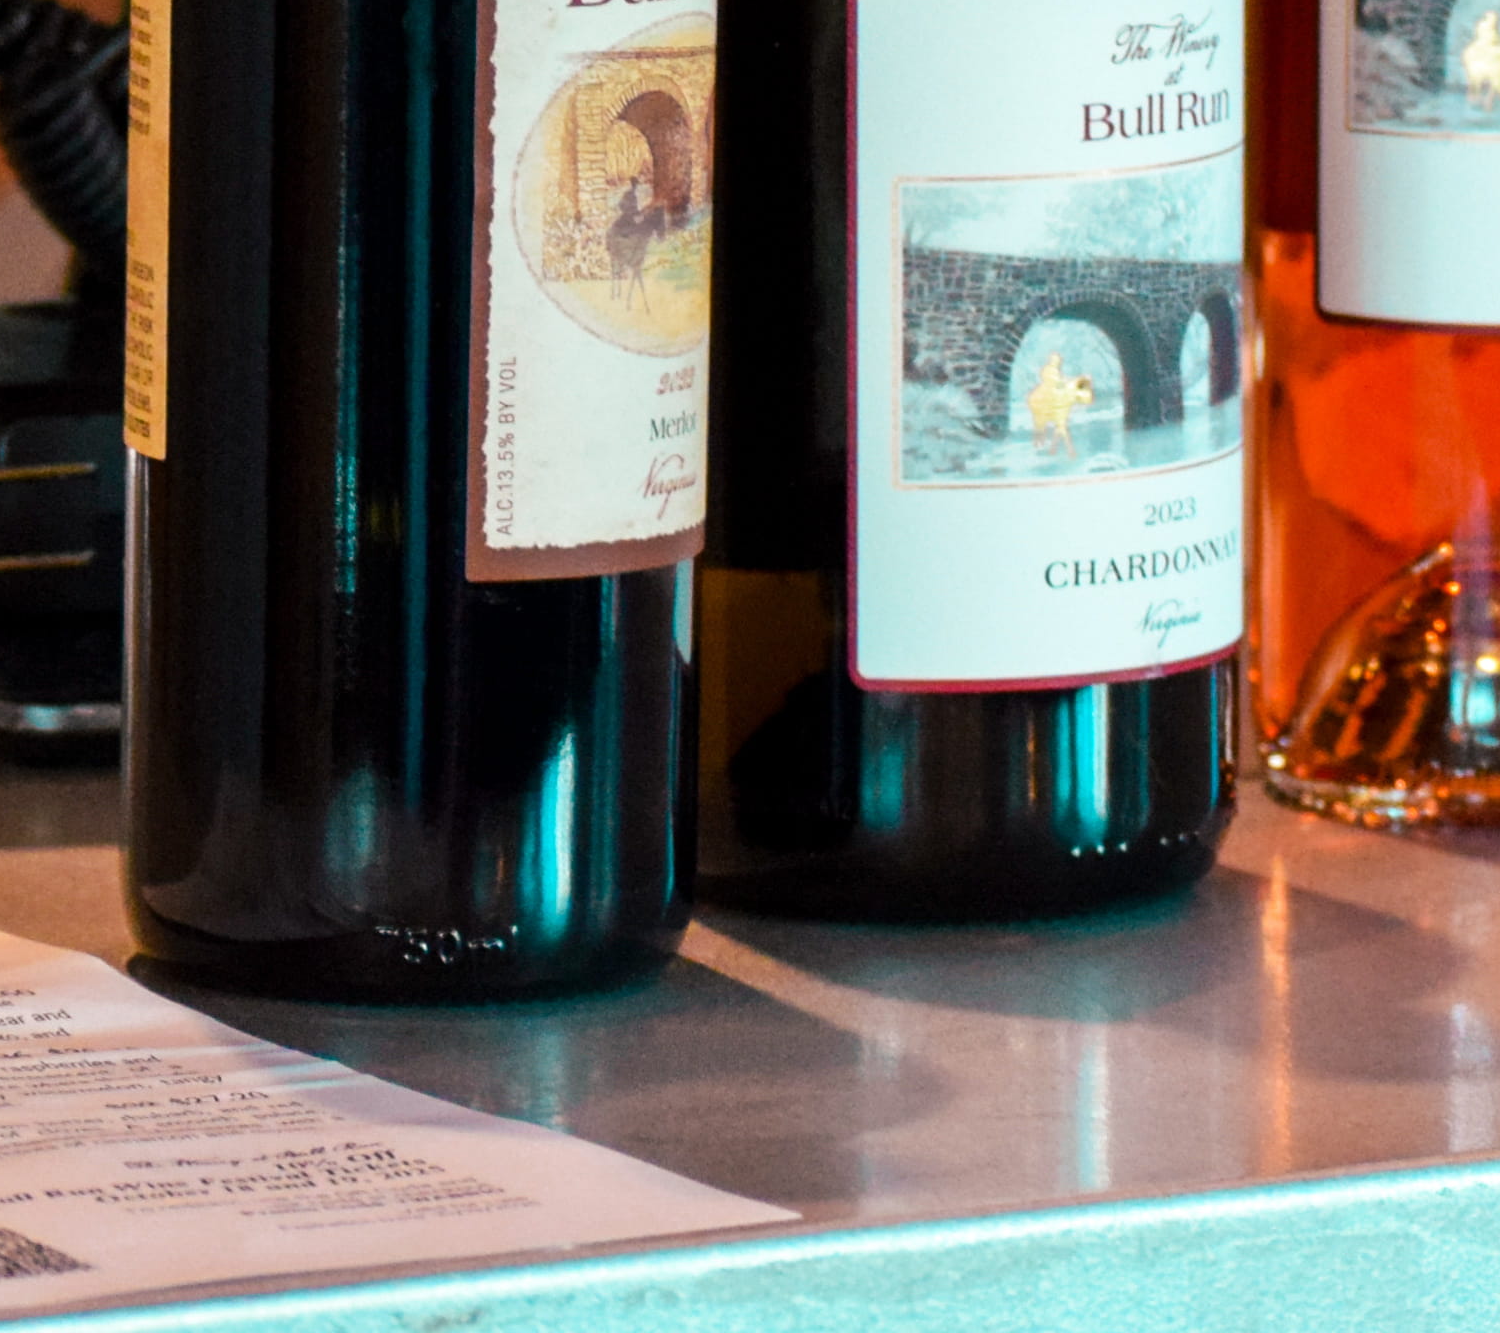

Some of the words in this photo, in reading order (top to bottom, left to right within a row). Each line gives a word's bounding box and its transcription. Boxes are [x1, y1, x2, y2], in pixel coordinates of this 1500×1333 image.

[1111, 23, 1155, 65] The
[1162, 9, 1221, 71] Winery
[1163, 62, 1186, 86] at
[1081, 92, 1166, 142] Bull
[1177, 88, 1231, 131] Run
[498, 356, 517, 394] VOL
[497, 400, 516, 424] BY
[649, 410, 697, 443] Merlot
[1143, 496, 1197, 526] 2023
[1135, 598, 1203, 650] Virginia
[31, 1007, 72, 1023] and
[31, 1026, 72, 1039] and
